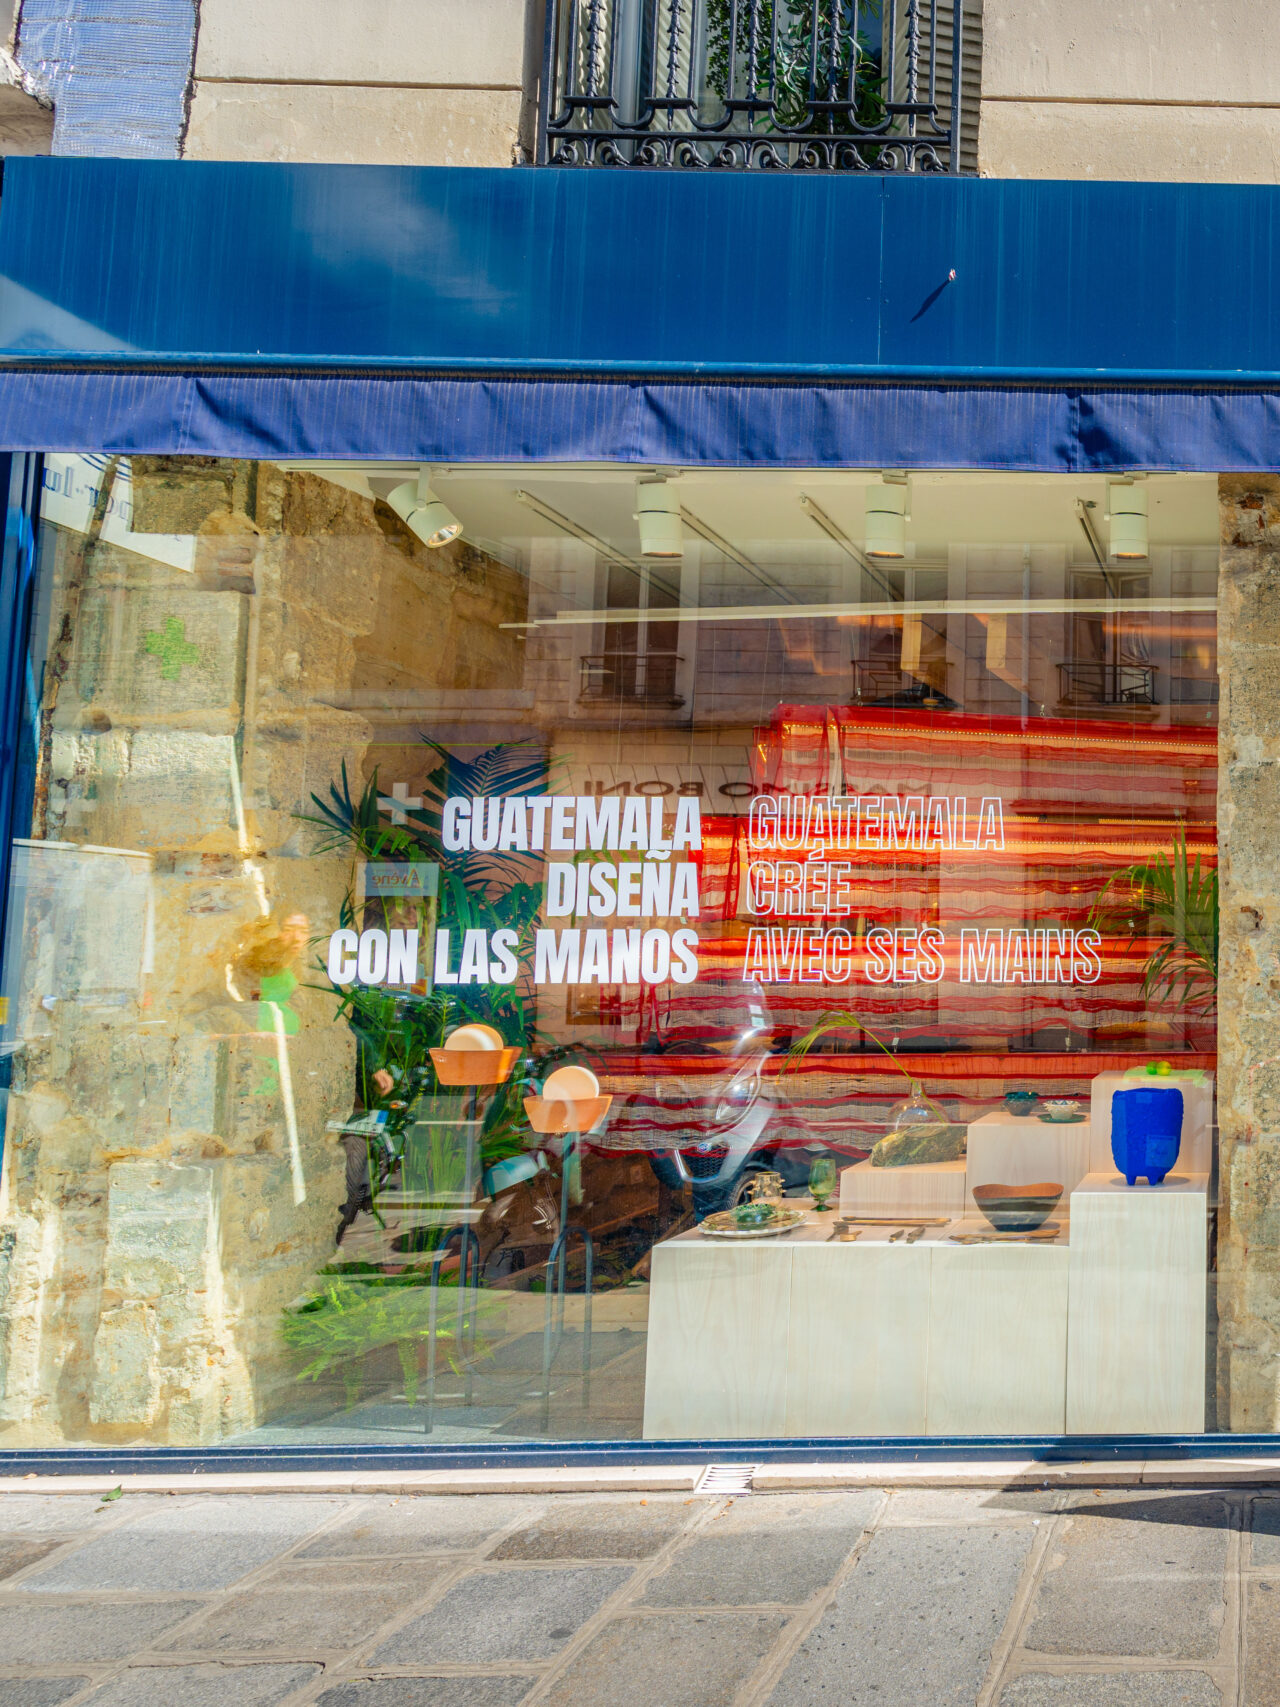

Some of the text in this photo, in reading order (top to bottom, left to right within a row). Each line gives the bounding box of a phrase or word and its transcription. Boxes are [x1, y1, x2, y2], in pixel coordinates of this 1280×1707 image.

[441, 795, 702, 851] GUATEMALA
[748, 794, 1005, 851] GUATEMALA
[546, 848, 700, 917] DISEÑA
[747, 849, 851, 916] CRÉE
[327, 928, 699, 985] CON LAS MANOS
[742, 927, 1102, 984] AVEC SES MAINS
